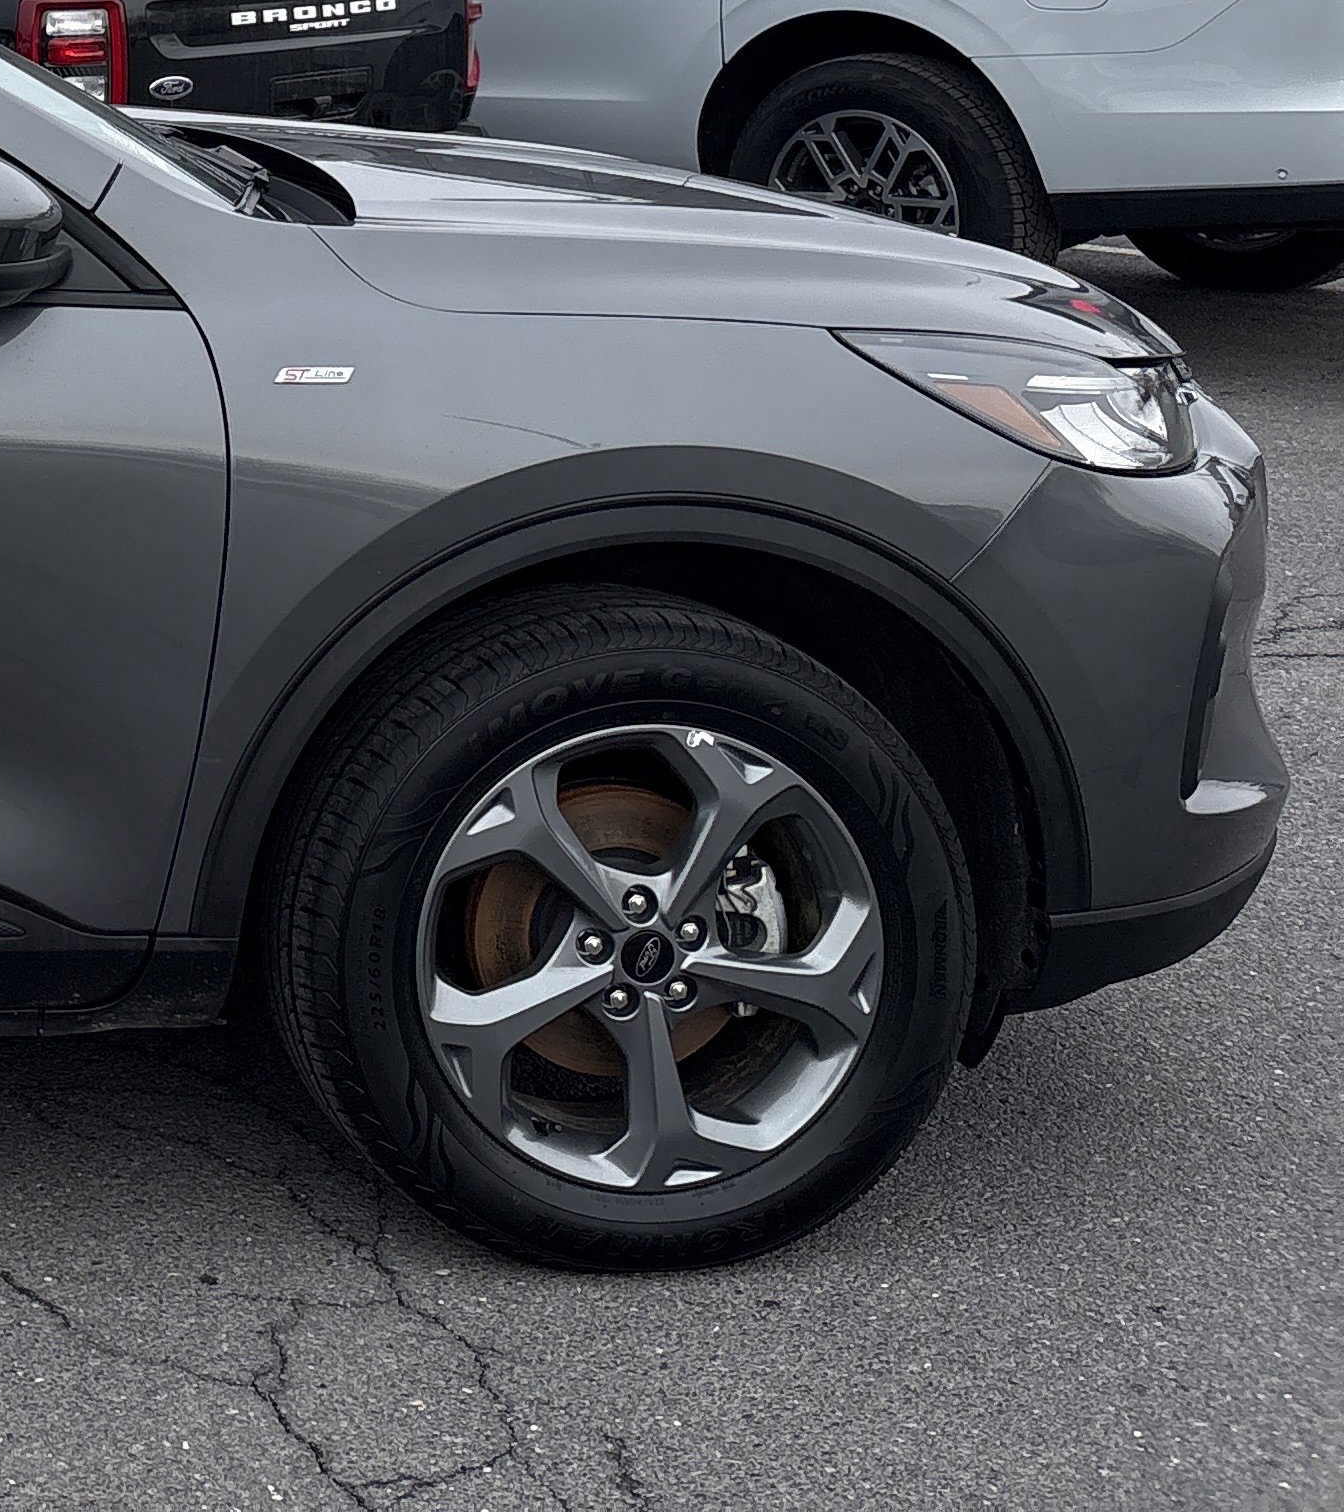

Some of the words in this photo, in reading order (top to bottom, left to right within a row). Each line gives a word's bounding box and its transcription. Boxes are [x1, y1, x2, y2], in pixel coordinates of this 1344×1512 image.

[288, 18, 351, 32] SPORT
[160, 80, 185, 94] Ford
[367, 903, 388, 1032] 225/60R18
